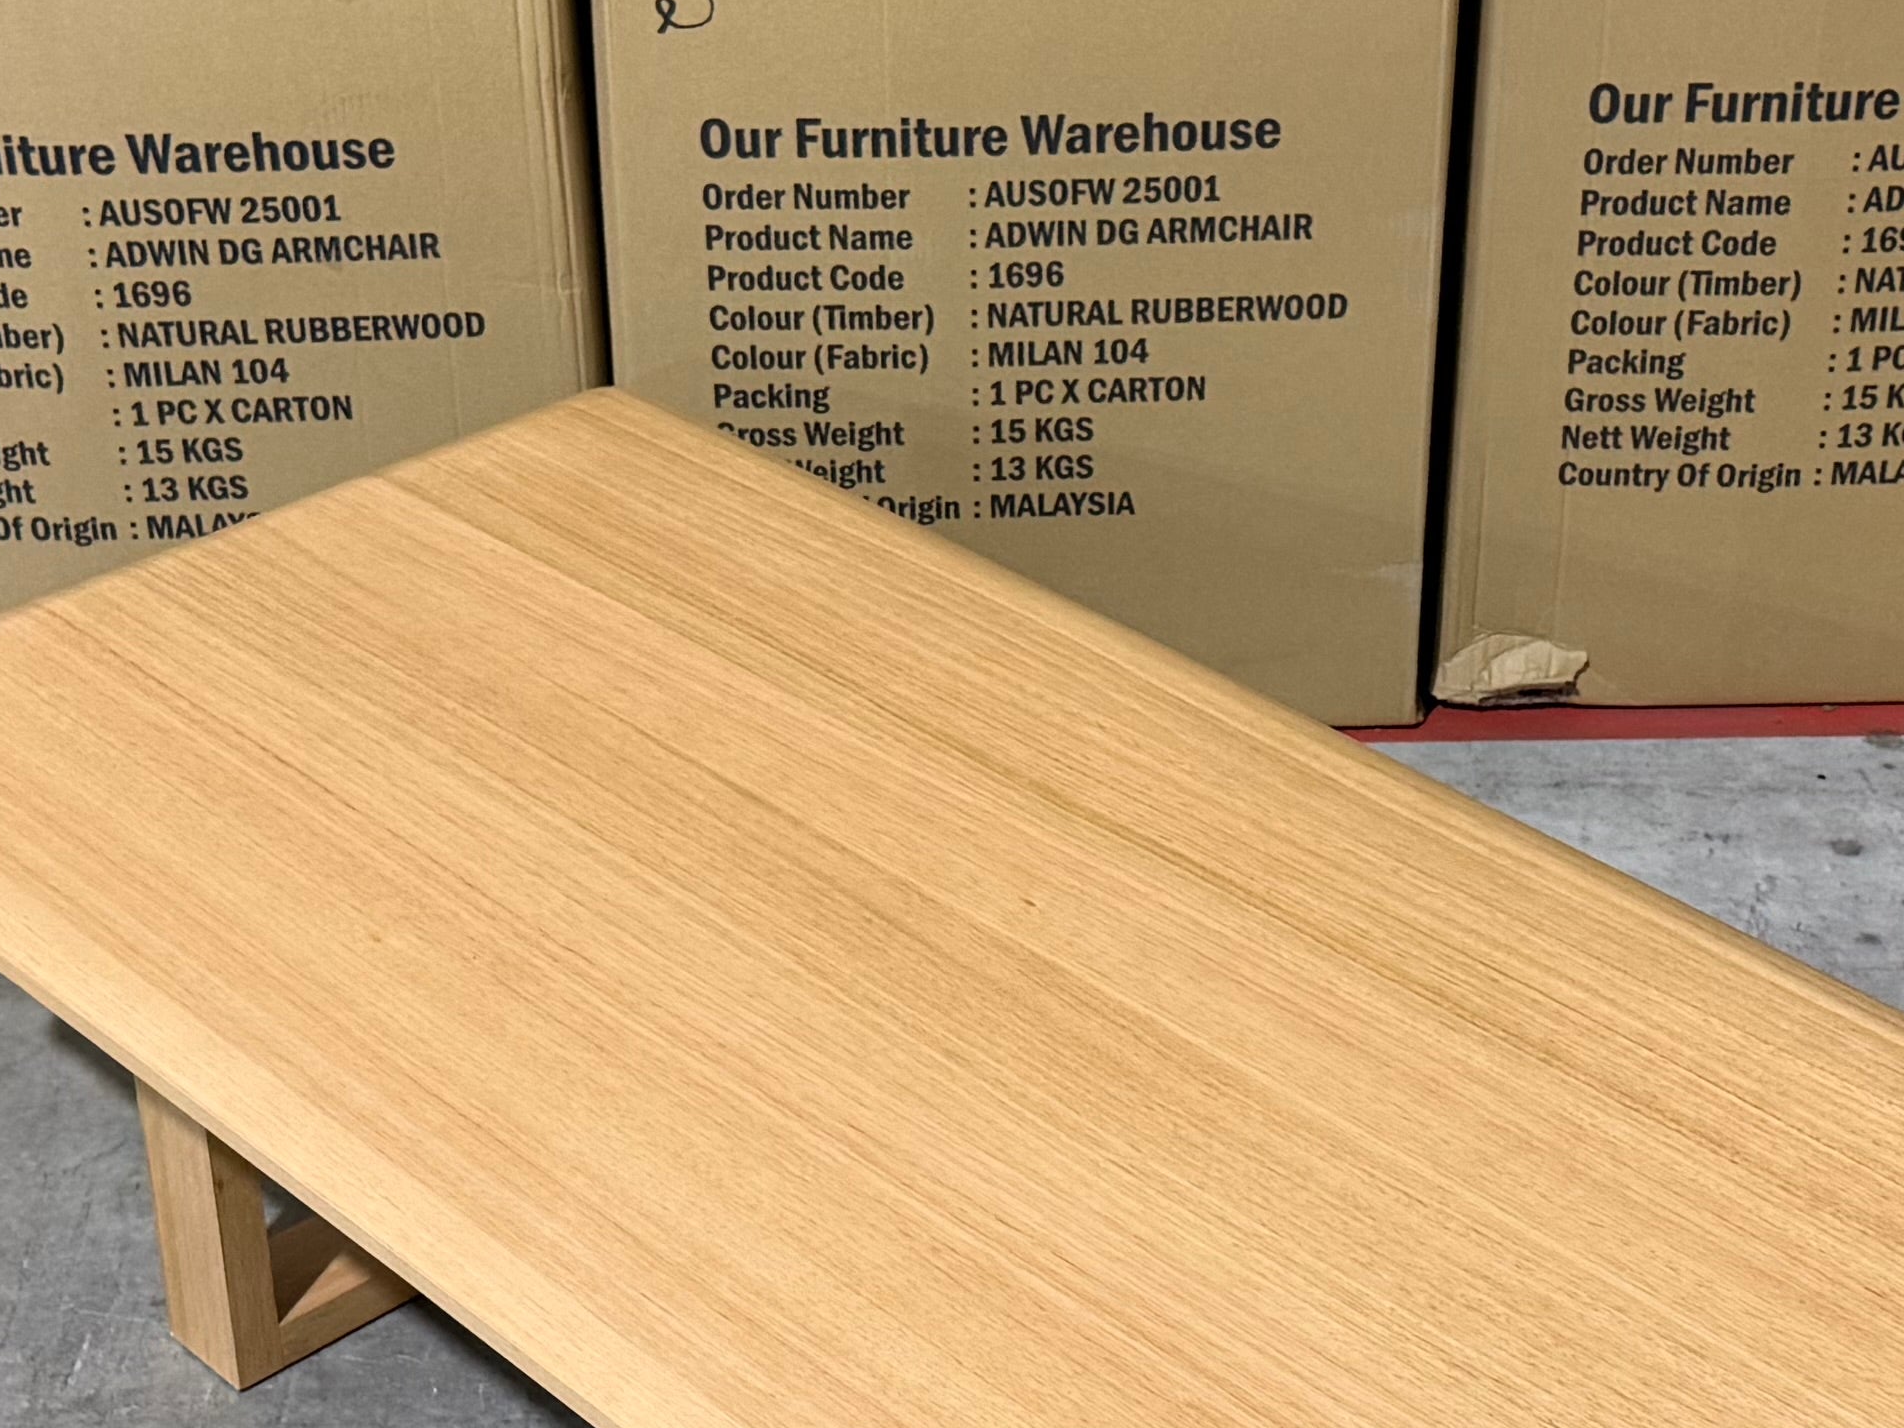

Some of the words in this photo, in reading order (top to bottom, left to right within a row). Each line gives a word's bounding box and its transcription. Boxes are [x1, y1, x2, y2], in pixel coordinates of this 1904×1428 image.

[1589, 82, 1673, 124] Our
[1685, 81, 1900, 123] Furniture
[124, 131, 395, 174] Warehouse
[700, 118, 783, 159] Our
[796, 117, 1007, 158] Furniture
[1020, 112, 1281, 155] Warehouse
[702, 183, 786, 210] Order
[793, 182, 911, 210] Number
[984, 177, 1116, 208] AUSOFW
[1122, 174, 1220, 204] 25001
[1577, 229, 1694, 256] Product
[1701, 229, 1777, 256] Code
[113, 280, 192, 308] 1696
[117, 319, 258, 348] NATURAL
[264, 311, 485, 344] RUBBERWOOD
[711, 344, 806, 370] Colour
[814, 343, 928, 375] (Fabric)
[988, 340, 1082, 367] MILAN
[1094, 338, 1149, 364] 104
[1568, 348, 1686, 380] Packing
[1846, 346, 1862, 372] 1
[136, 439, 174, 465] 15
[181, 437, 243, 463] KGS
[1558, 461, 1670, 492] Country
[1677, 462, 1711, 487] Of
[1716, 463, 1801, 493] Origin
